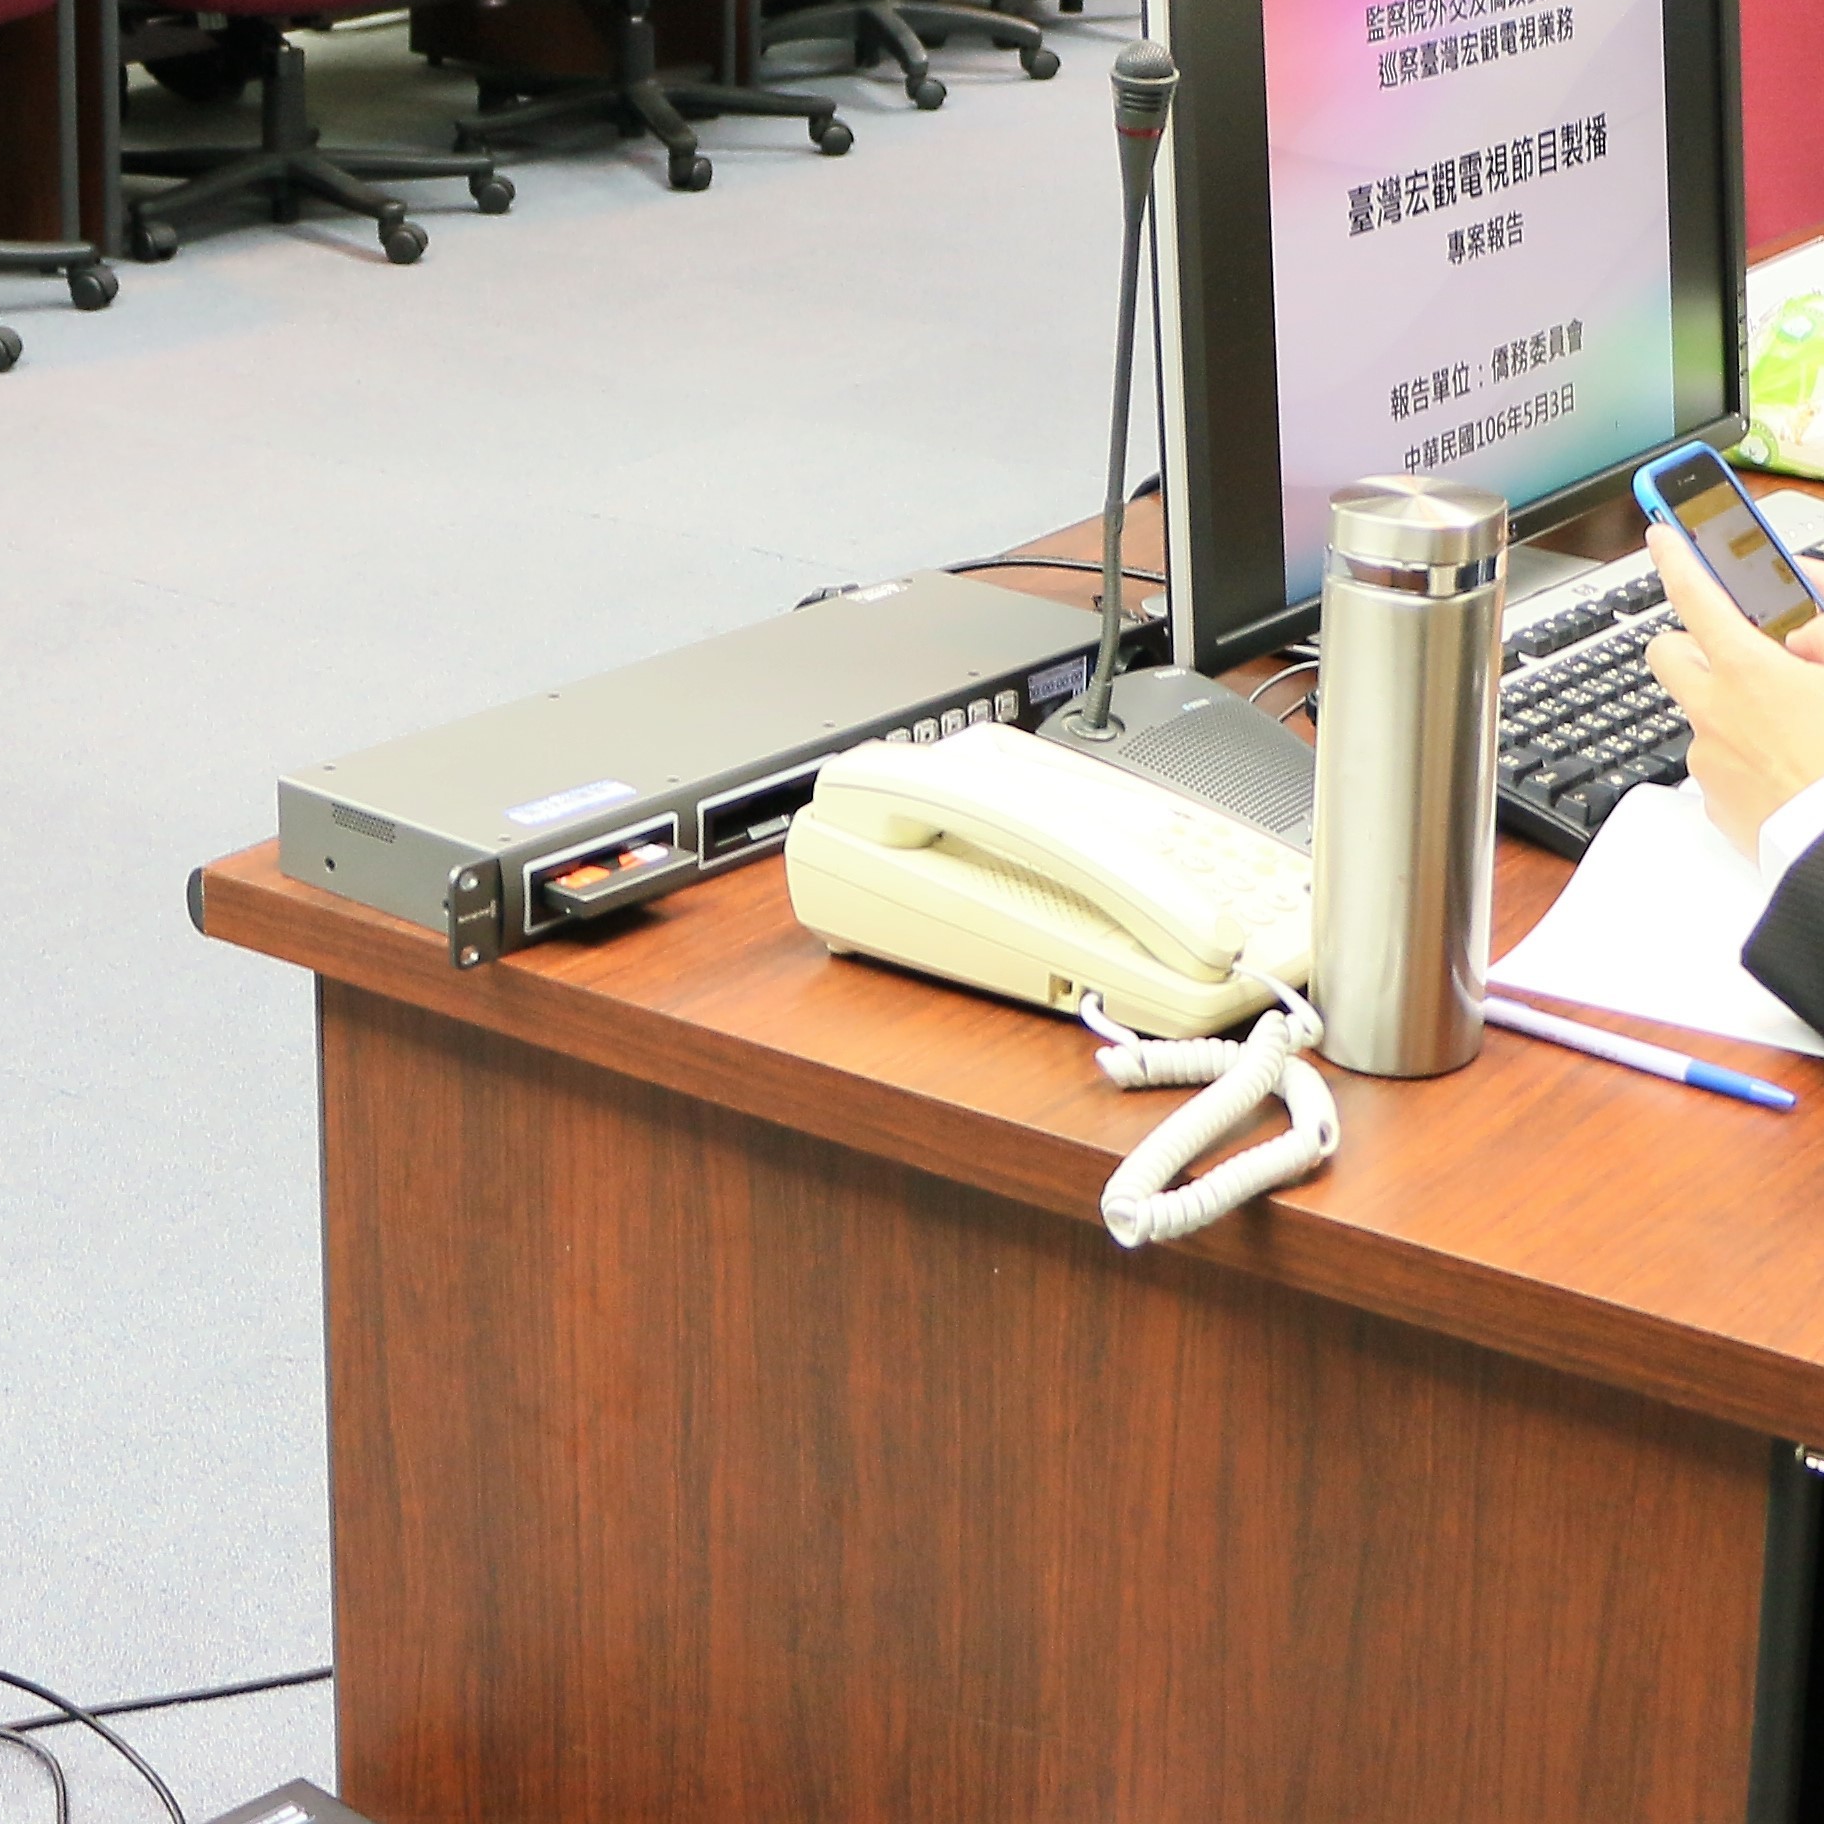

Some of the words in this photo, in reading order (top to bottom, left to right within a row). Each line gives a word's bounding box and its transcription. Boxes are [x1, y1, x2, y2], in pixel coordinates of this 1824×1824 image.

[1378, 6, 1575, 90] 巡察臺灣宏觀電視業務
[1348, 112, 1608, 237] 臺灣宏觀電視節目製播
[1447, 210, 1524, 266] 專案報告
[1404, 383, 1576, 476] 中華民國106年5月3日
